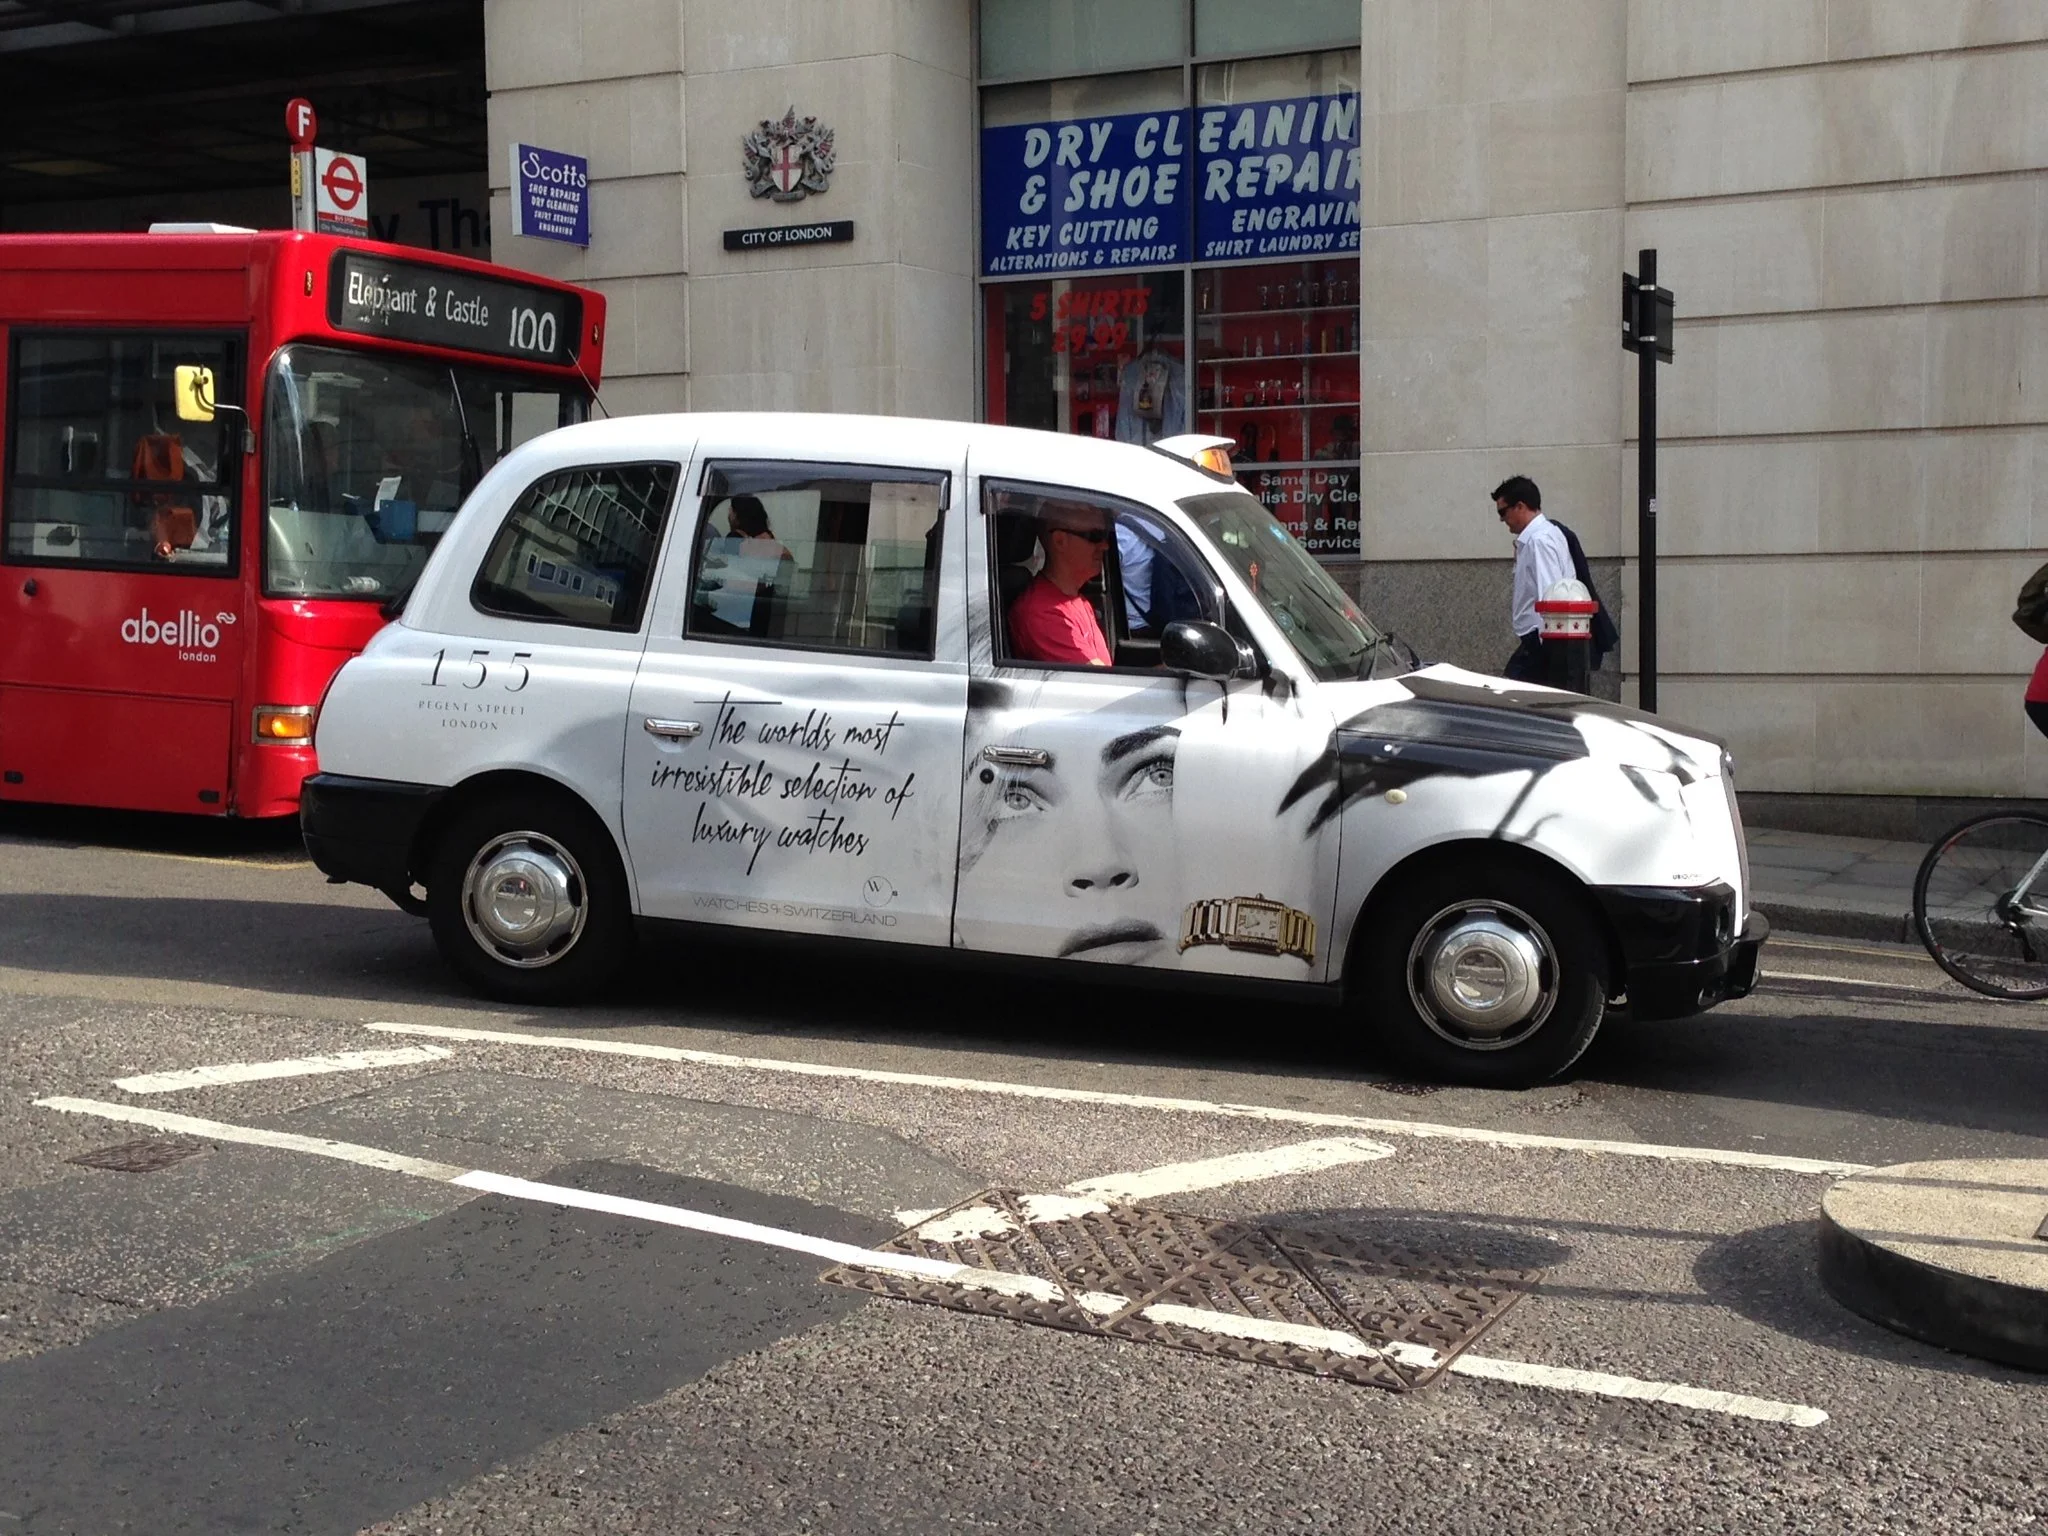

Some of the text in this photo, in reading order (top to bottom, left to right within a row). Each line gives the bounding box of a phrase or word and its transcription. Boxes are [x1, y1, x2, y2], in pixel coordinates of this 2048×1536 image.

[297, 104, 311, 137] F
[1023, 98, 1358, 169] DRY CLEANIN
[521, 151, 587, 188] Scotts
[1020, 147, 1361, 215] & SHOE REPAIR
[528, 183, 581, 202] SHOE REPAIRS
[531, 196, 579, 214] DRY CLEANING
[1231, 201, 1361, 233] ENGRAVIN
[741, 227, 832, 245] CITY OF LONDON
[1006, 216, 1159, 251] KEY CUTTING
[1205, 231, 1360, 257] SHIRT LAUNDRY SE
[990, 244, 1177, 272] ALTERATIONS & REPAIRS
[425, 286, 437, 318] &
[445, 289, 489, 327] Castle
[509, 306, 557, 353] 100
[1030, 287, 1152, 321] 5 SHIRTS
[1260, 471, 1350, 487] Same Day
[1292, 490, 1324, 505] Dry
[1329, 489, 1361, 503] Cle
[1313, 517, 1329, 531] &
[1334, 517, 1361, 532] Re
[121, 607, 220, 649] abellio
[178, 650, 217, 662] london
[421, 648, 532, 692] 155
[442, 718, 499, 731] LONDON
[693, 690, 783, 750] The
[843, 710, 905, 756] most
[650, 758, 915, 820] irresistible selection of
[692, 801, 870, 876] luxury watches
[694, 897, 769, 914] WATCHES
[783, 904, 897, 928] SWITZERLAND
